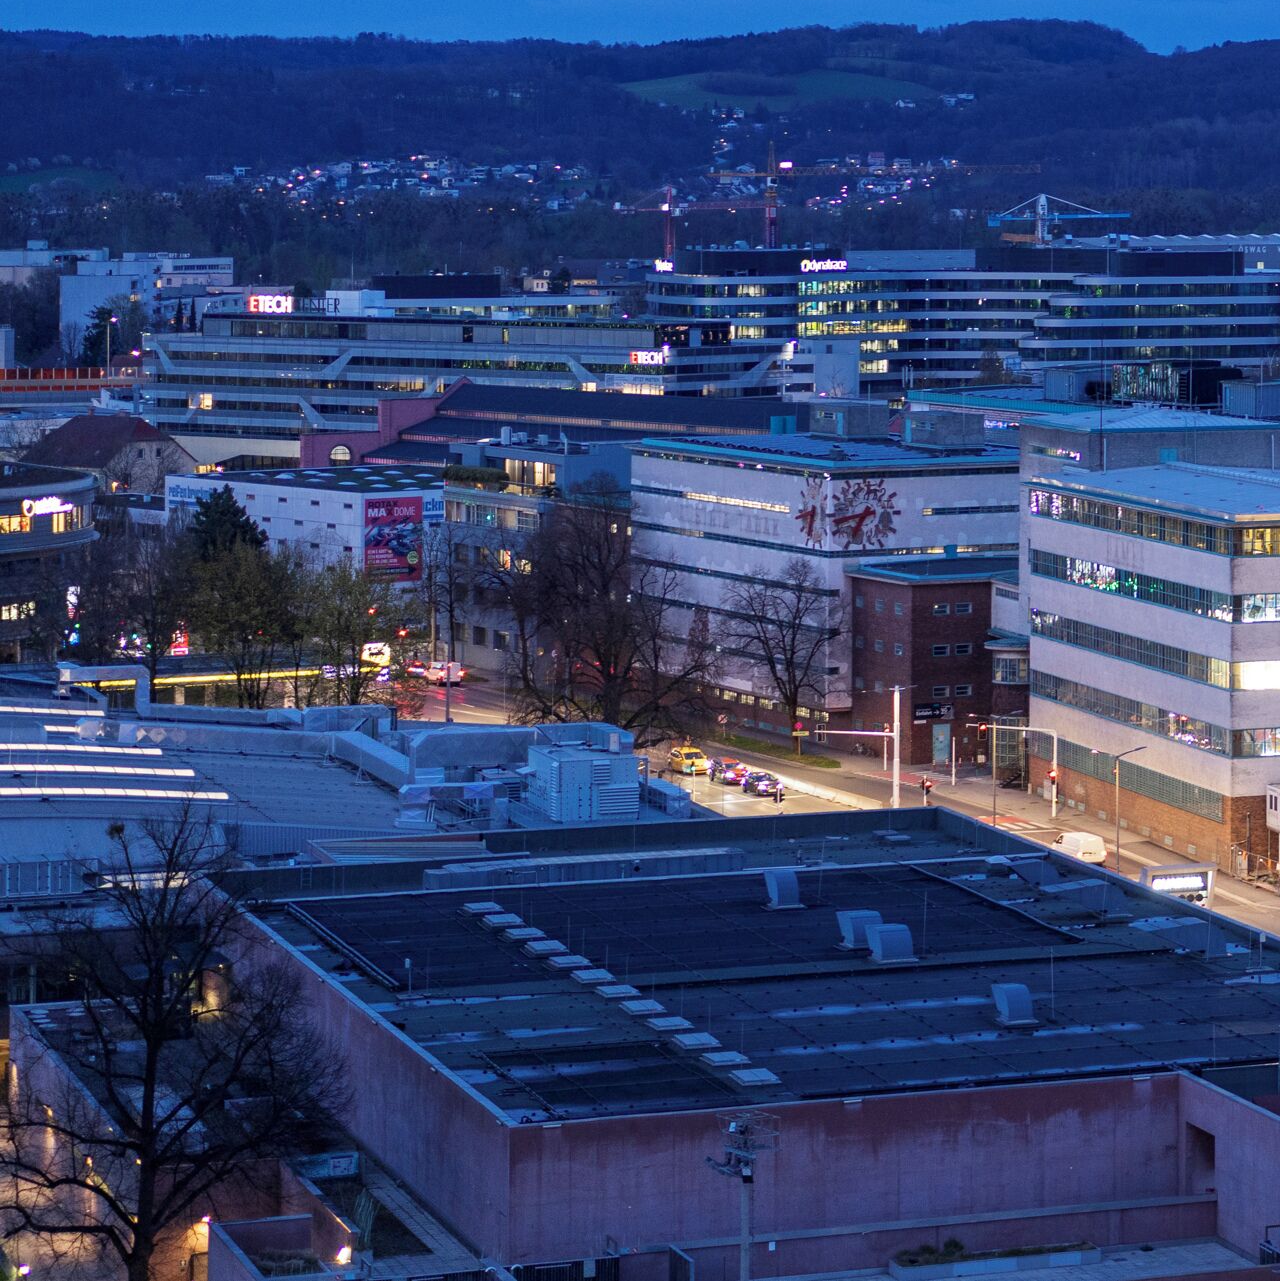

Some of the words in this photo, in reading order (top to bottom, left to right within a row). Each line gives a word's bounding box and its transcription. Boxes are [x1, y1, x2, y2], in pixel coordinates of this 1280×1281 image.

[810, 260, 847, 271] dynatrace
[249, 294, 292, 313] ETECH
[630, 352, 663, 365] ETECH
[394, 506, 416, 516] DOME
